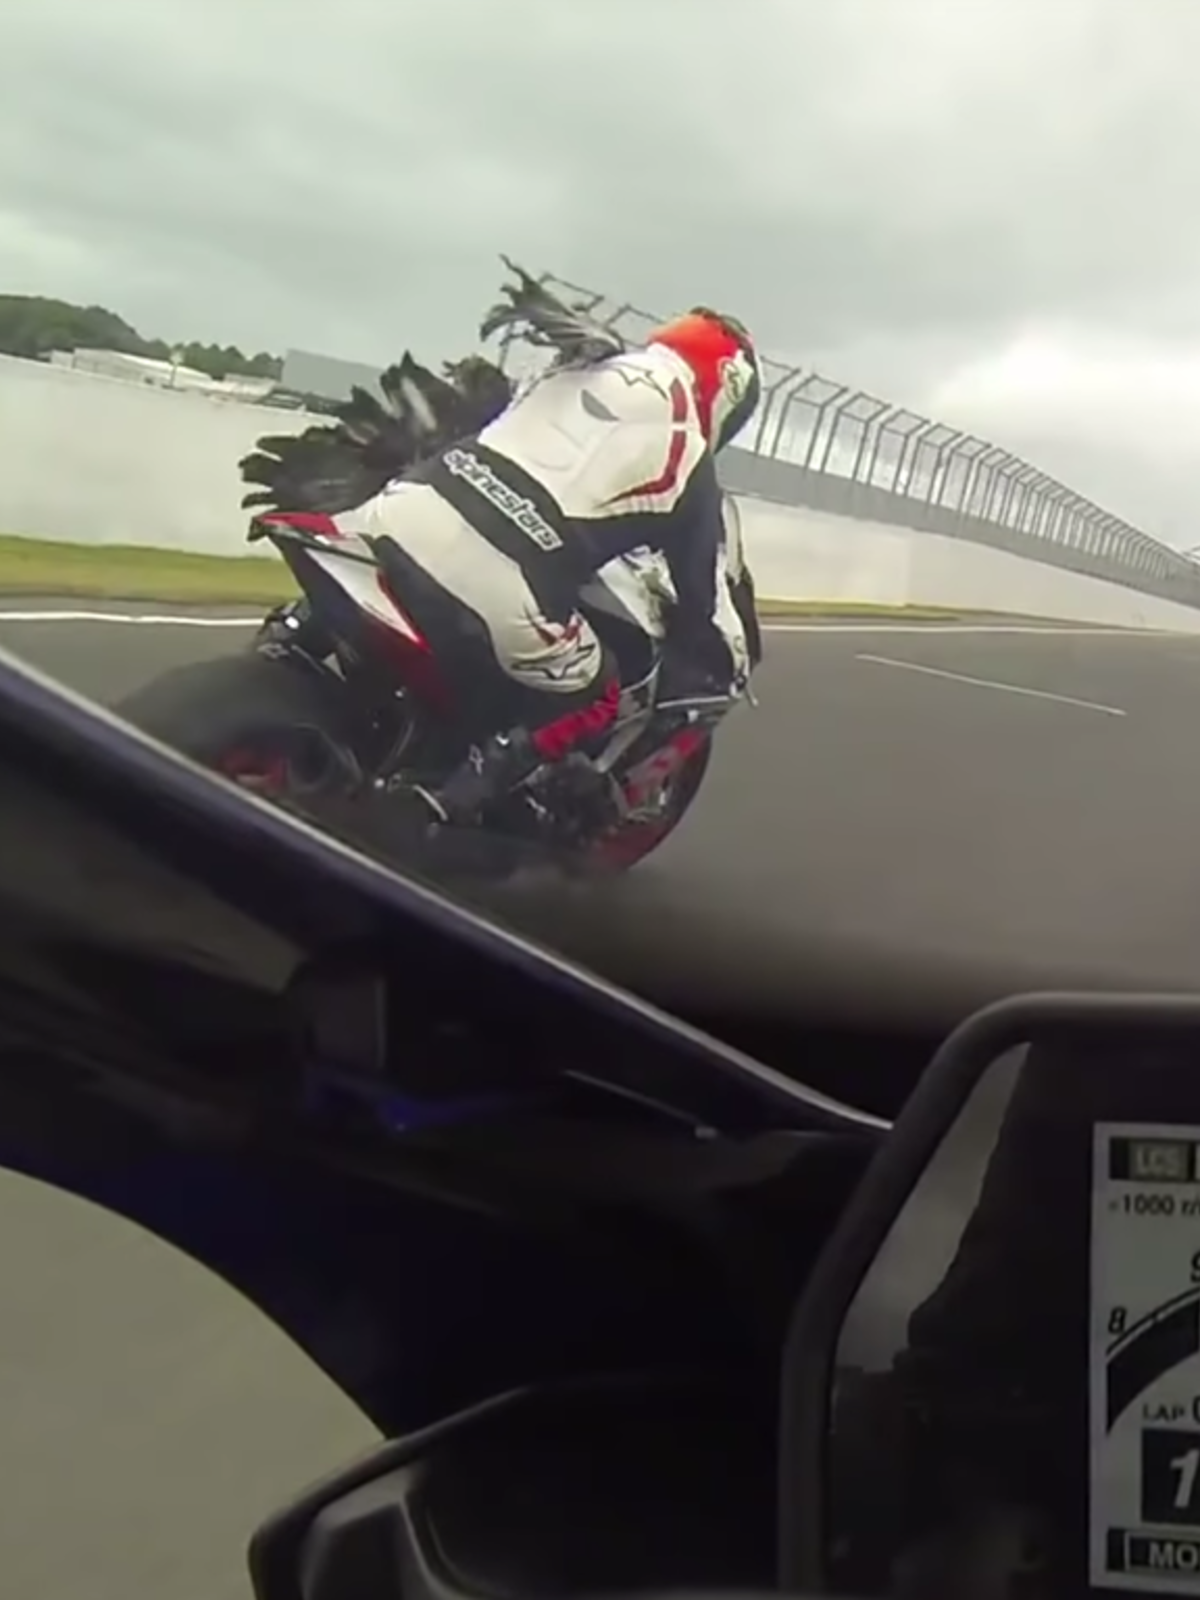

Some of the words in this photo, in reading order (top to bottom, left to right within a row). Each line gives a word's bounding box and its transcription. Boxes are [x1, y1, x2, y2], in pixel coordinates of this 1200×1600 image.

[442, 448, 564, 551] alpinestars
[1108, 1306, 1127, 1334] 8
[1142, 1404, 1185, 1422] LAP
